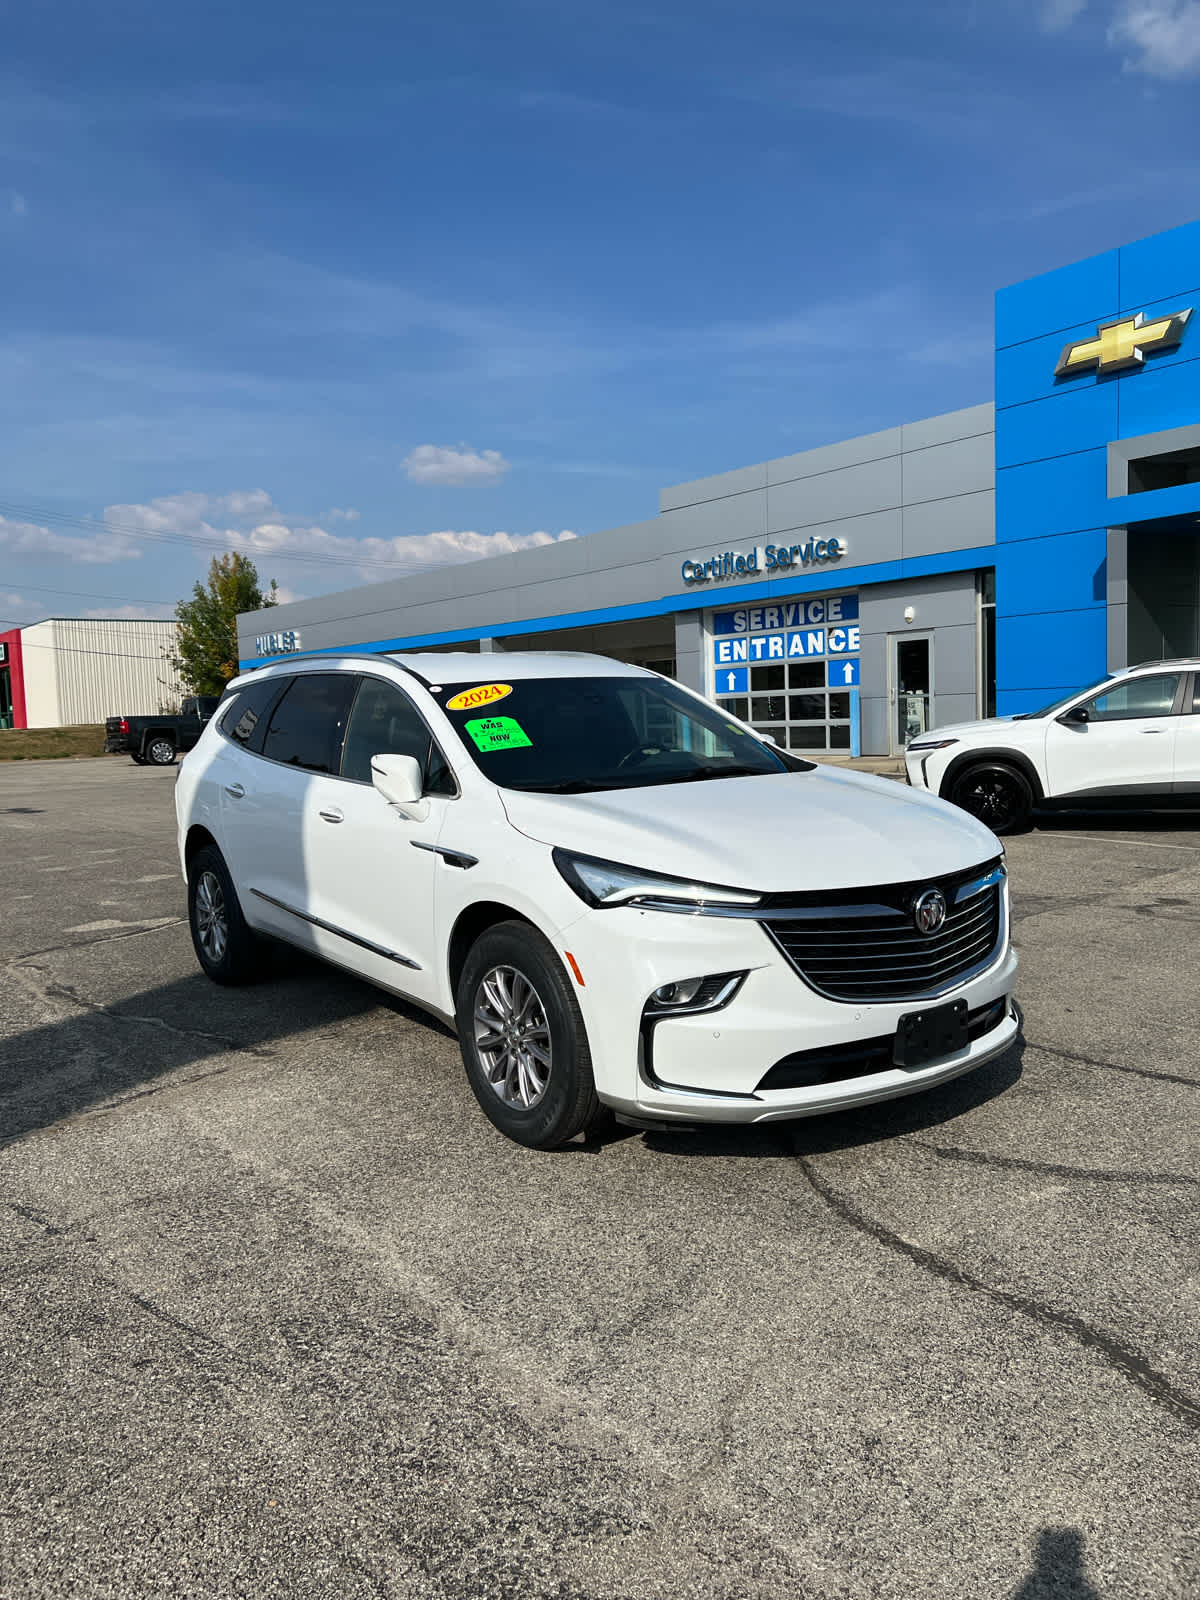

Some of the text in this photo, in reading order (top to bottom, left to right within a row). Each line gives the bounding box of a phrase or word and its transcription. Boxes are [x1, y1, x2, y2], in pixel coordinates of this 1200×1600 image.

[681, 536, 841, 582] Certified Service
[733, 597, 843, 632] SERVICE
[718, 627, 860, 662] ENTRANCE
[459, 685, 503, 708] 2024
[481, 722, 503, 730] WAS
[489, 734, 510, 742] NOW
